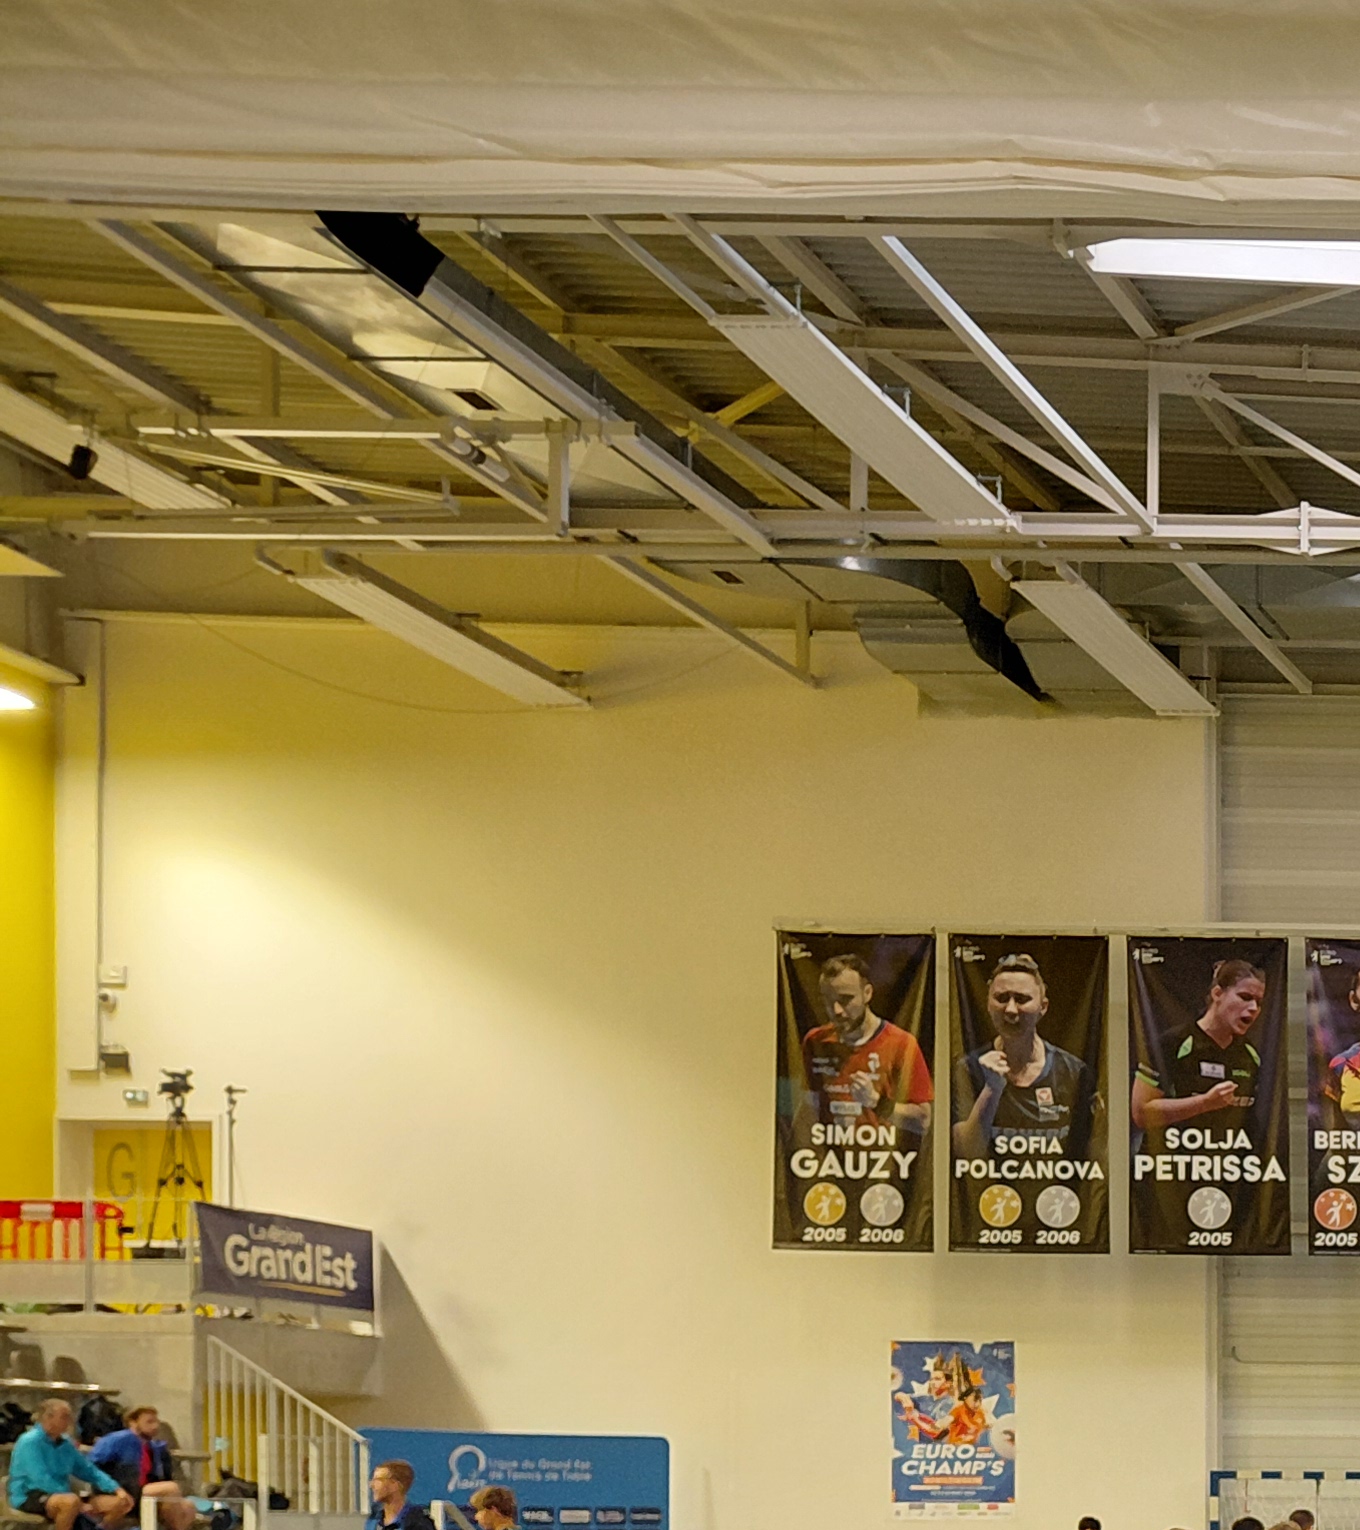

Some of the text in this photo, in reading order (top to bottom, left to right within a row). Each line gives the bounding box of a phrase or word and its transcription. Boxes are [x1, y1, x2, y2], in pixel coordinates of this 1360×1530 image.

[811, 1124, 896, 1146] SIMON
[995, 1135, 1063, 1155] SOFIA
[1165, 1128, 1252, 1150] SOLJA
[106, 1142, 138, 1203] G
[790, 1150, 917, 1179] GAUZY
[955, 1159, 1104, 1180] POLCANOVA
[1134, 1154, 1286, 1182] PETRISSA
[802, 1227, 904, 1243] 2005 2006
[978, 1229, 1080, 1245] 2005 2006
[1187, 1232, 1232, 1246] 2005
[1314, 1232, 1358, 1247] 2005
[912, 1443, 975, 1459] EURO
[901, 1460, 1005, 1476] CHAMP'S
